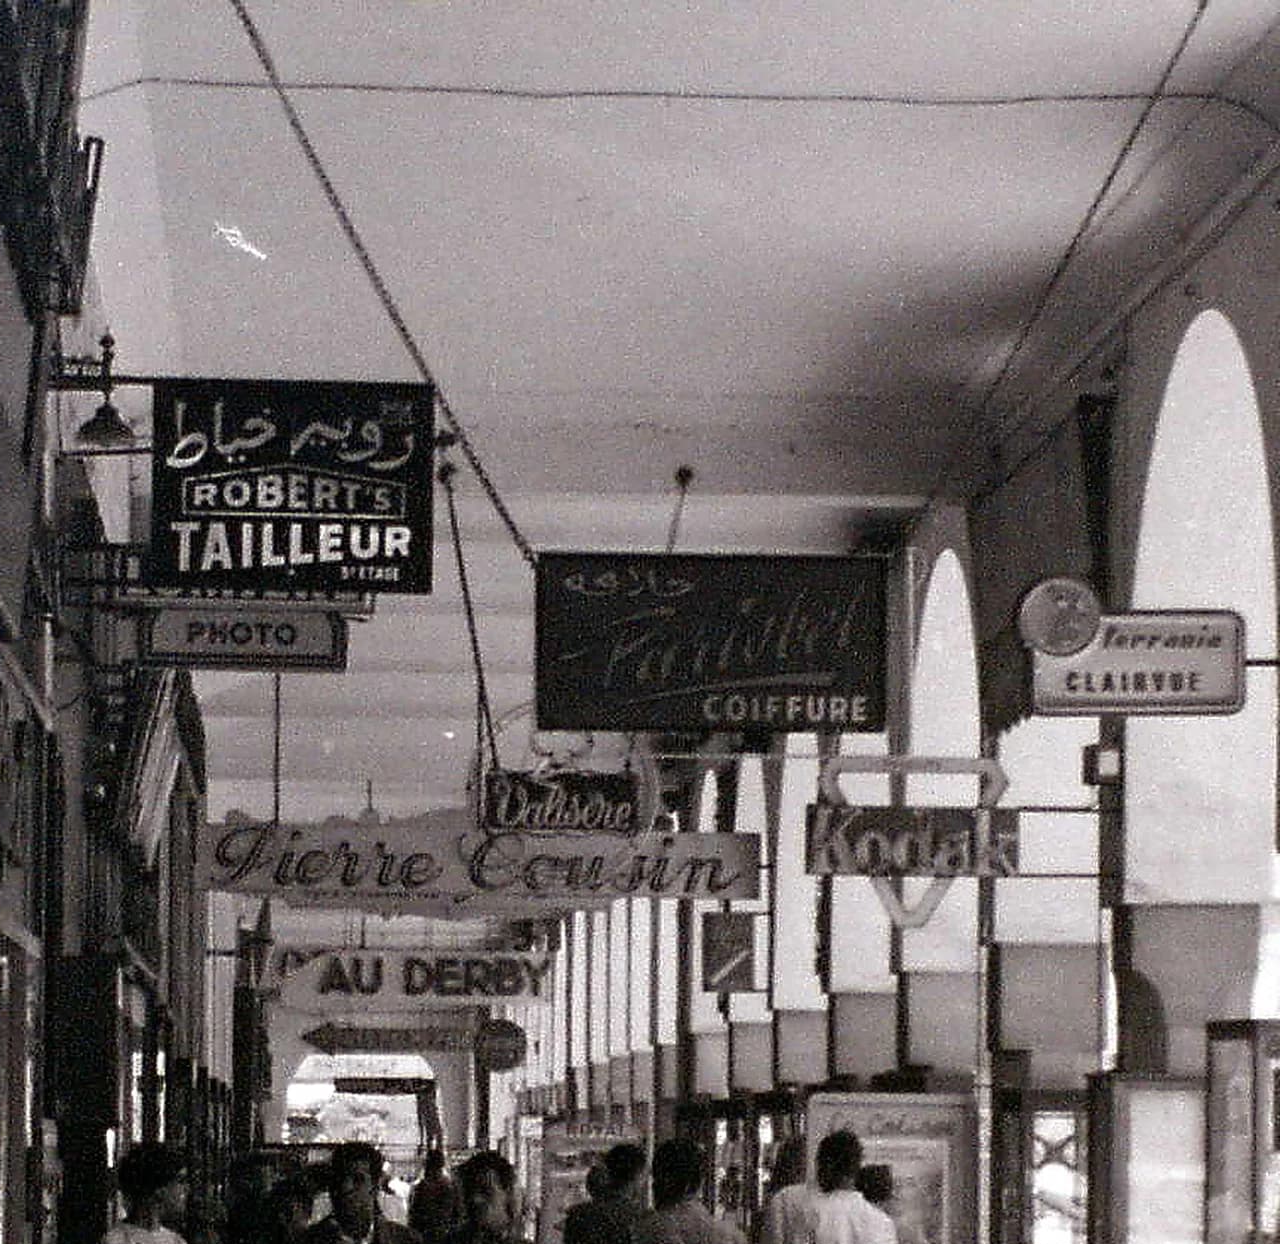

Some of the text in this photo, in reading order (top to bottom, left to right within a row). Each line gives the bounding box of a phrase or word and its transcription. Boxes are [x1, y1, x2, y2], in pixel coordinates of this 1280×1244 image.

[165, 399, 277, 470] خياط
[192, 473, 392, 511] ROBERT'S
[170, 520, 412, 572] TAILLEUR
[186, 620, 298, 647] PHOTO
[1065, 671, 1202, 693] CLAIRVUE
[701, 693, 869, 723] COIFFURE
[213, 820, 744, 892] Pierre Cousin
[810, 807, 1018, 876] Kodak
[318, 955, 384, 995] AU
[403, 955, 550, 996] DERBY
